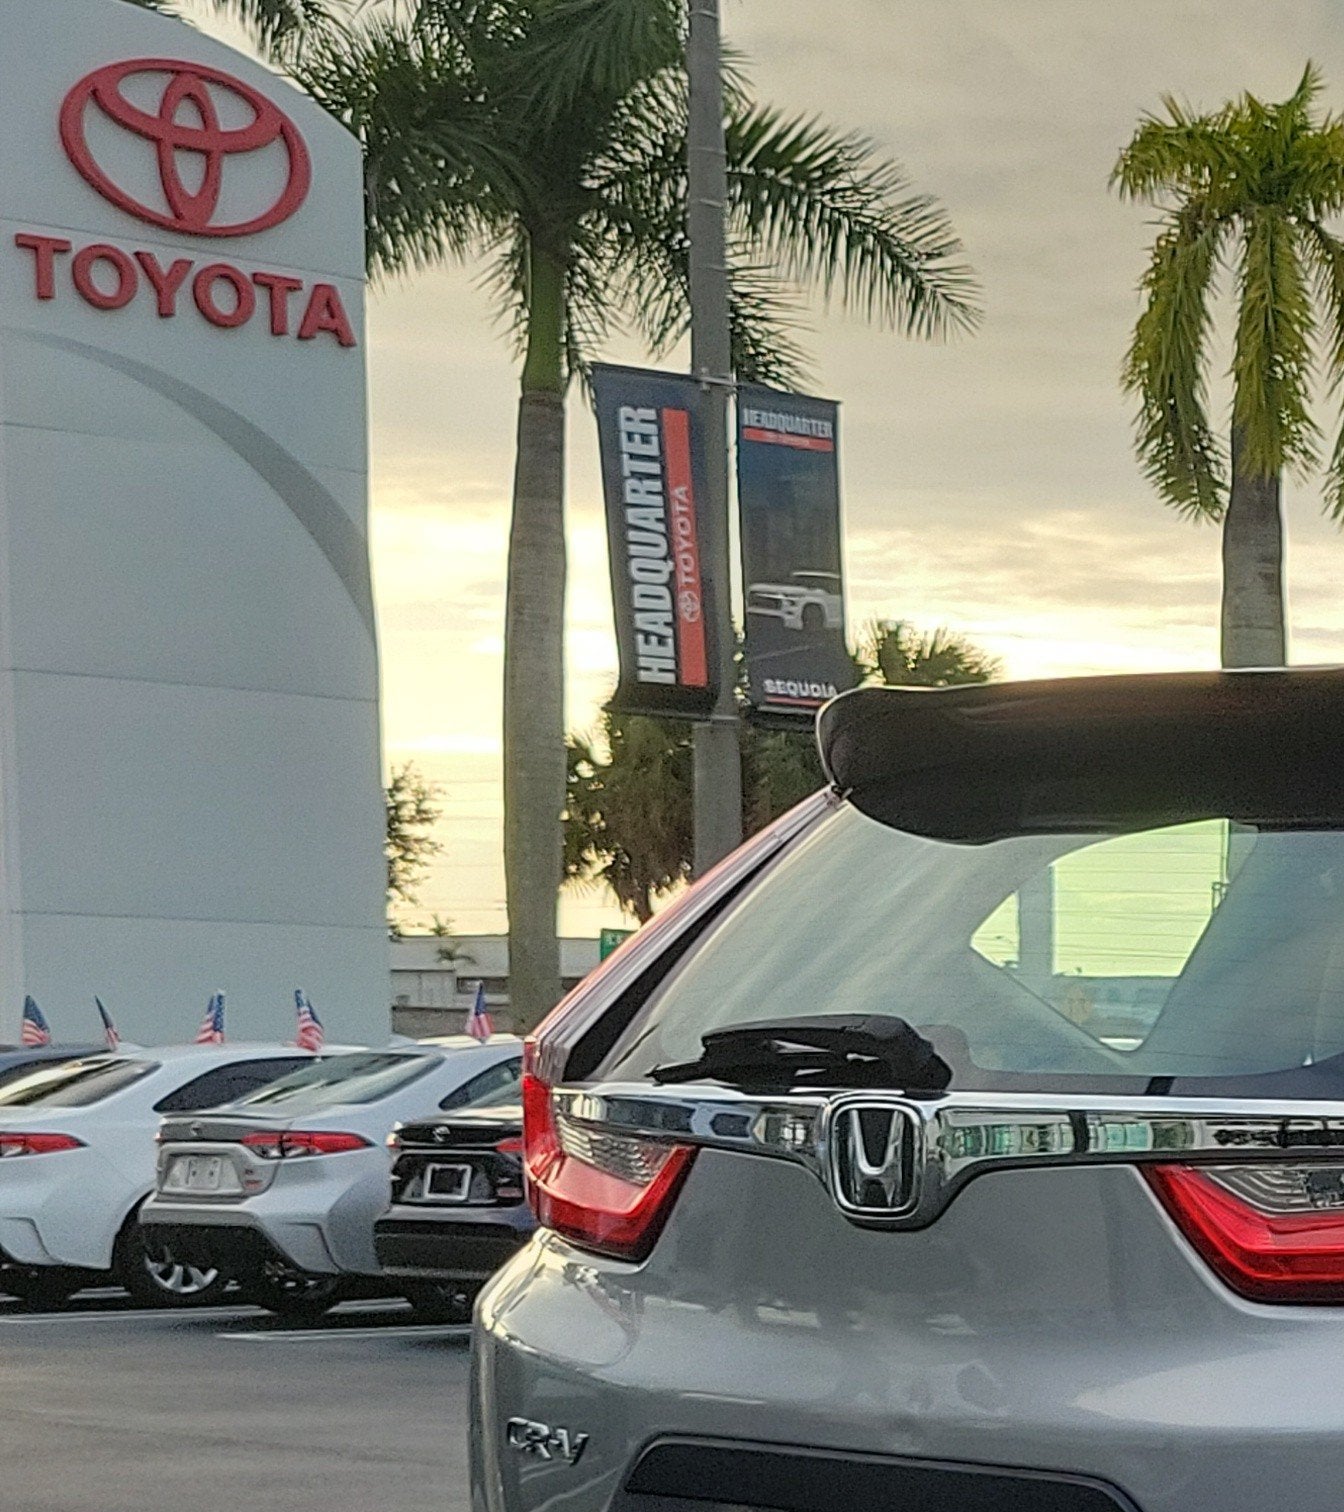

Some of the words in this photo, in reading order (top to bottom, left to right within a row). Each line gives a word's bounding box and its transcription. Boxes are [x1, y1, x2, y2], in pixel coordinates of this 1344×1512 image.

[15, 233, 357, 347] TOYOTA
[743, 408, 833, 439] HEADQUARTER
[618, 405, 677, 685] HEADQUARTER
[671, 486, 696, 588] TOYOTA
[764, 679, 838, 699] SEQUOIA
[506, 1417, 589, 1467] CR-V
